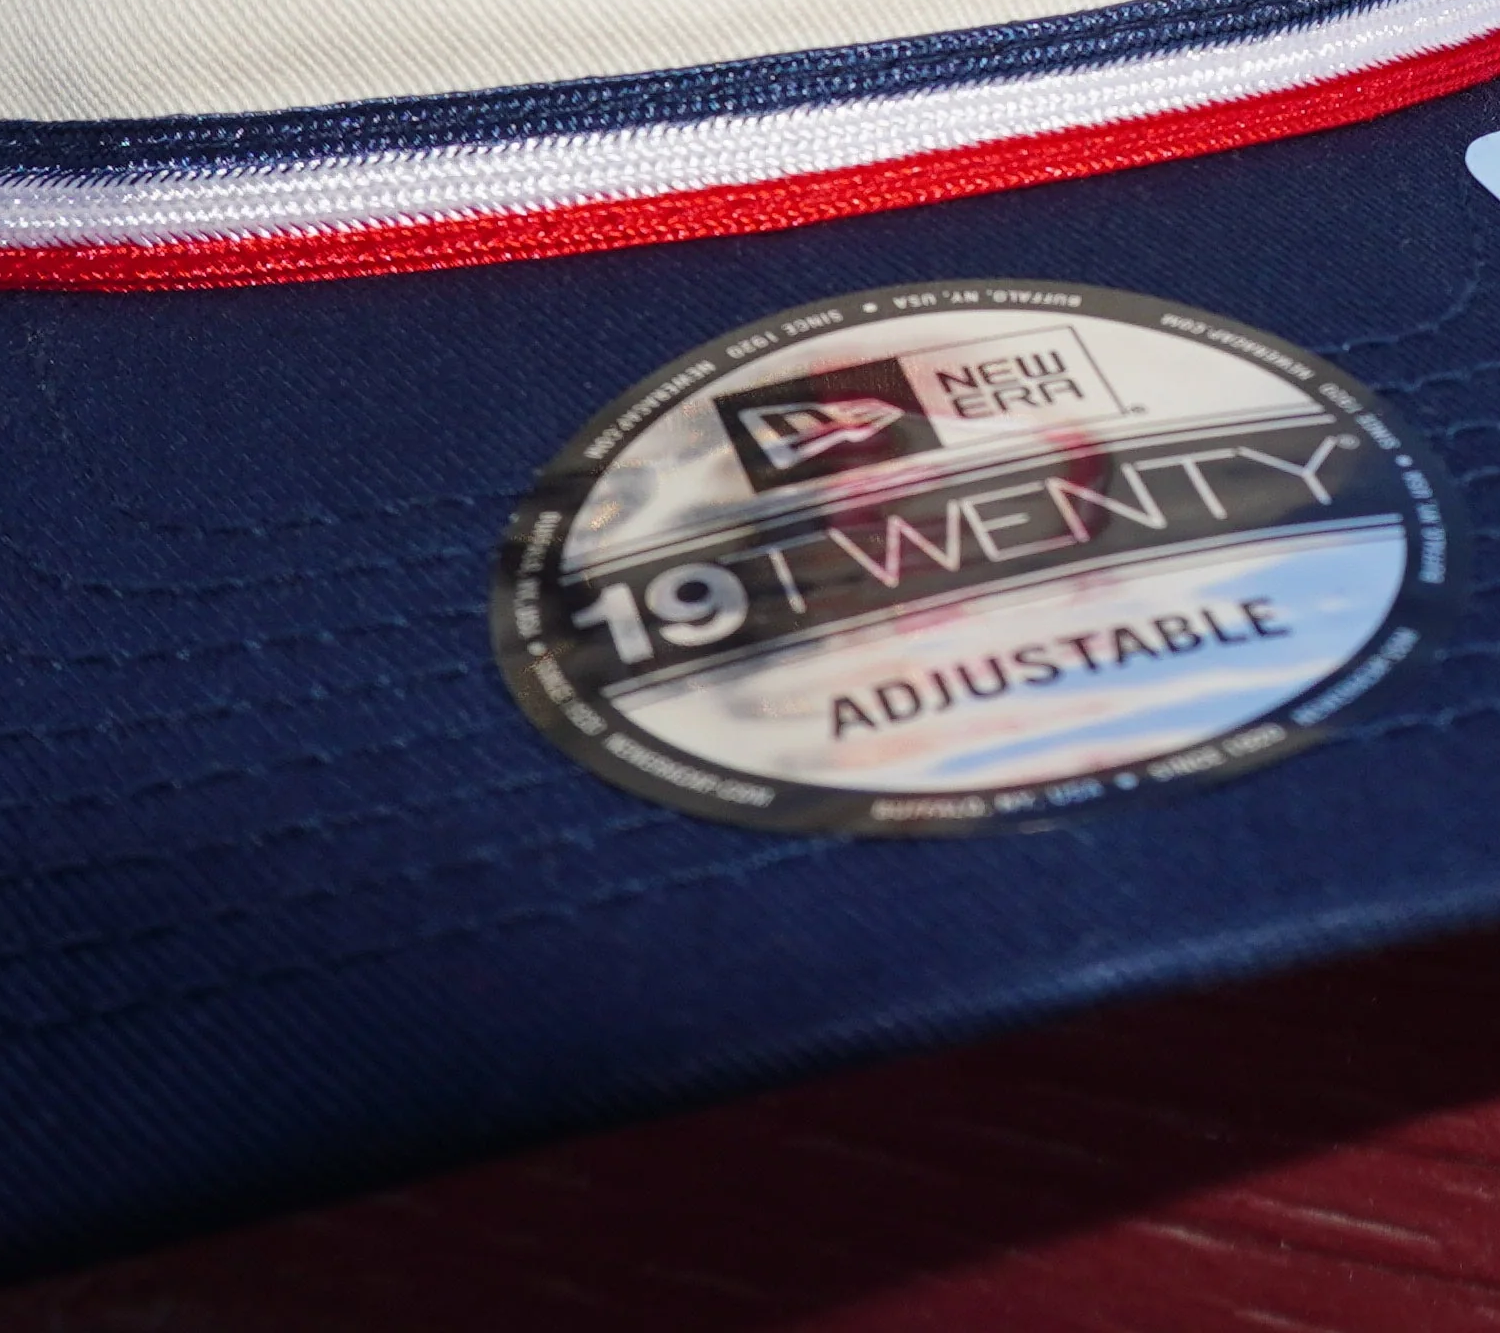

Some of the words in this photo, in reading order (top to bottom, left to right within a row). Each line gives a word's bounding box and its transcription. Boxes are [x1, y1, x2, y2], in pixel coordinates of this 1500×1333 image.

[892, 290, 938, 310] USA
[780, 309, 844, 337] SINCE
[725, 331, 781, 360] 1920
[935, 350, 1068, 394] NEW
[952, 378, 1085, 419] ERA
[572, 434, 1336, 664] 19TWENTY
[829, 597, 1291, 741] ADJUSTABLE
